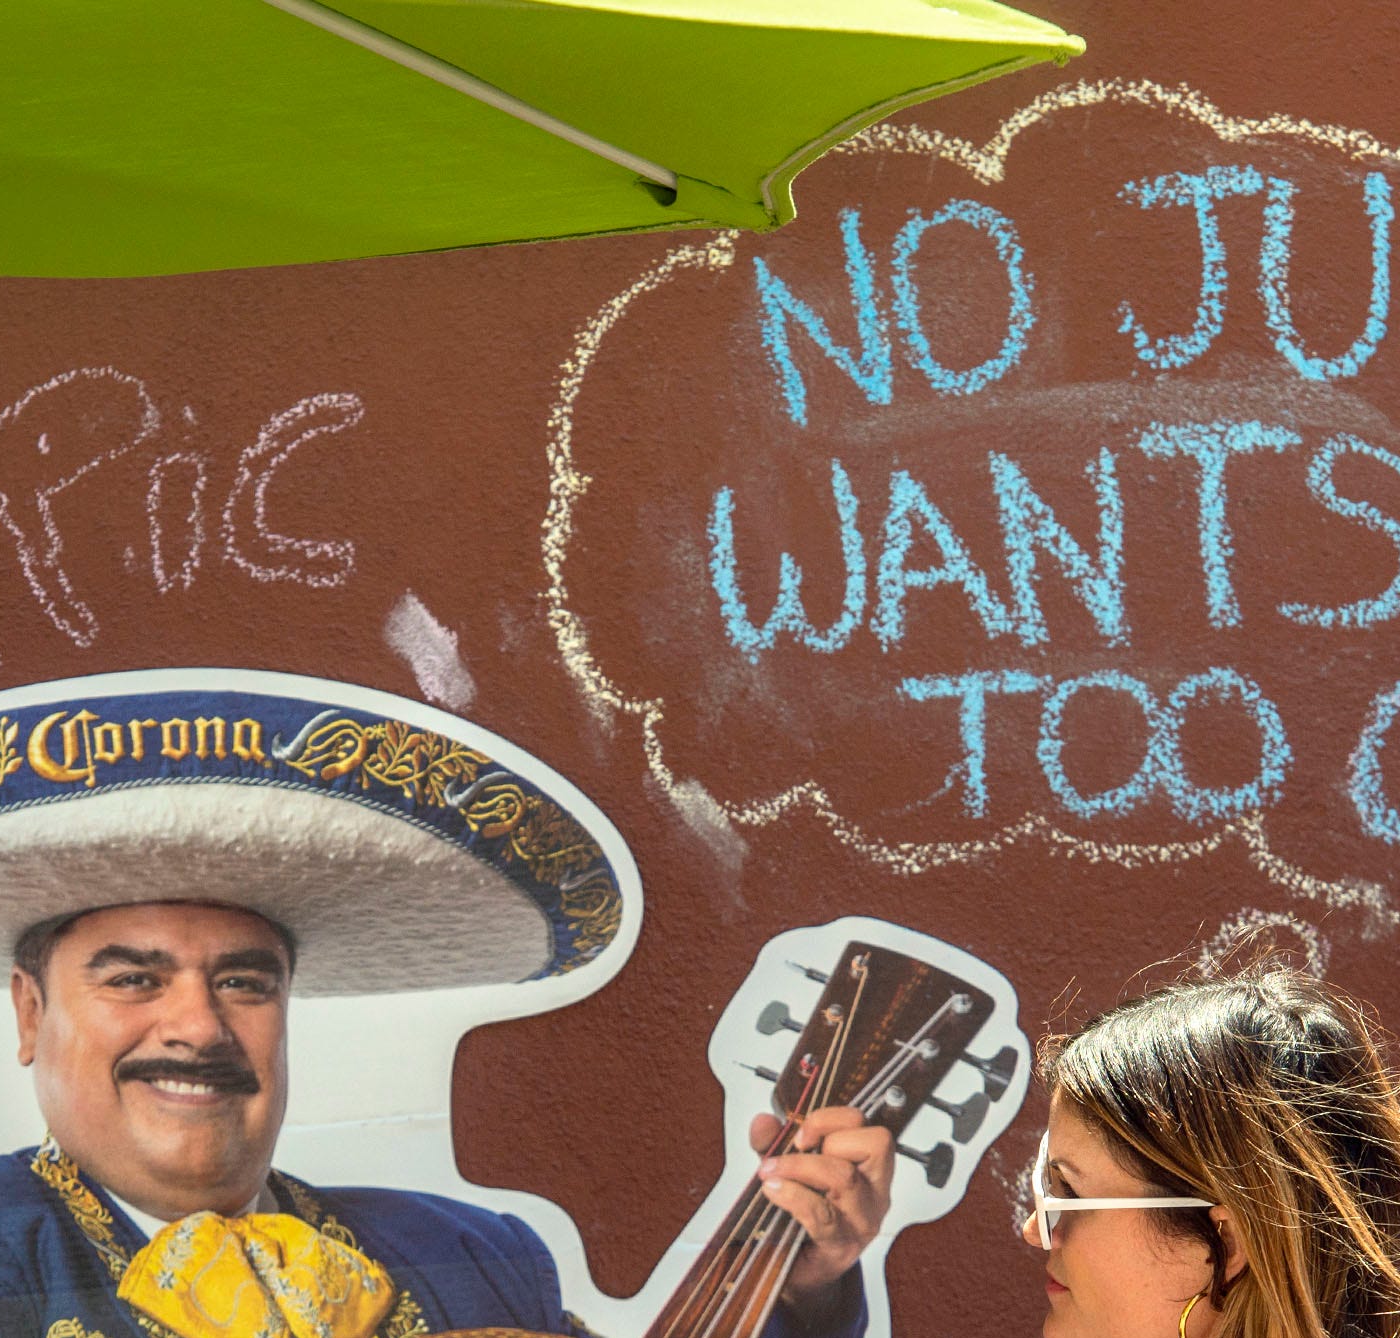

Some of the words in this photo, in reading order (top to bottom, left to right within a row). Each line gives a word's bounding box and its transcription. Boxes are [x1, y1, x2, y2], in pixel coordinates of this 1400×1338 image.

[754, 198, 1037, 426] NO
[26, 709, 267, 782] Corona
[894, 666, 1294, 820] TOO
